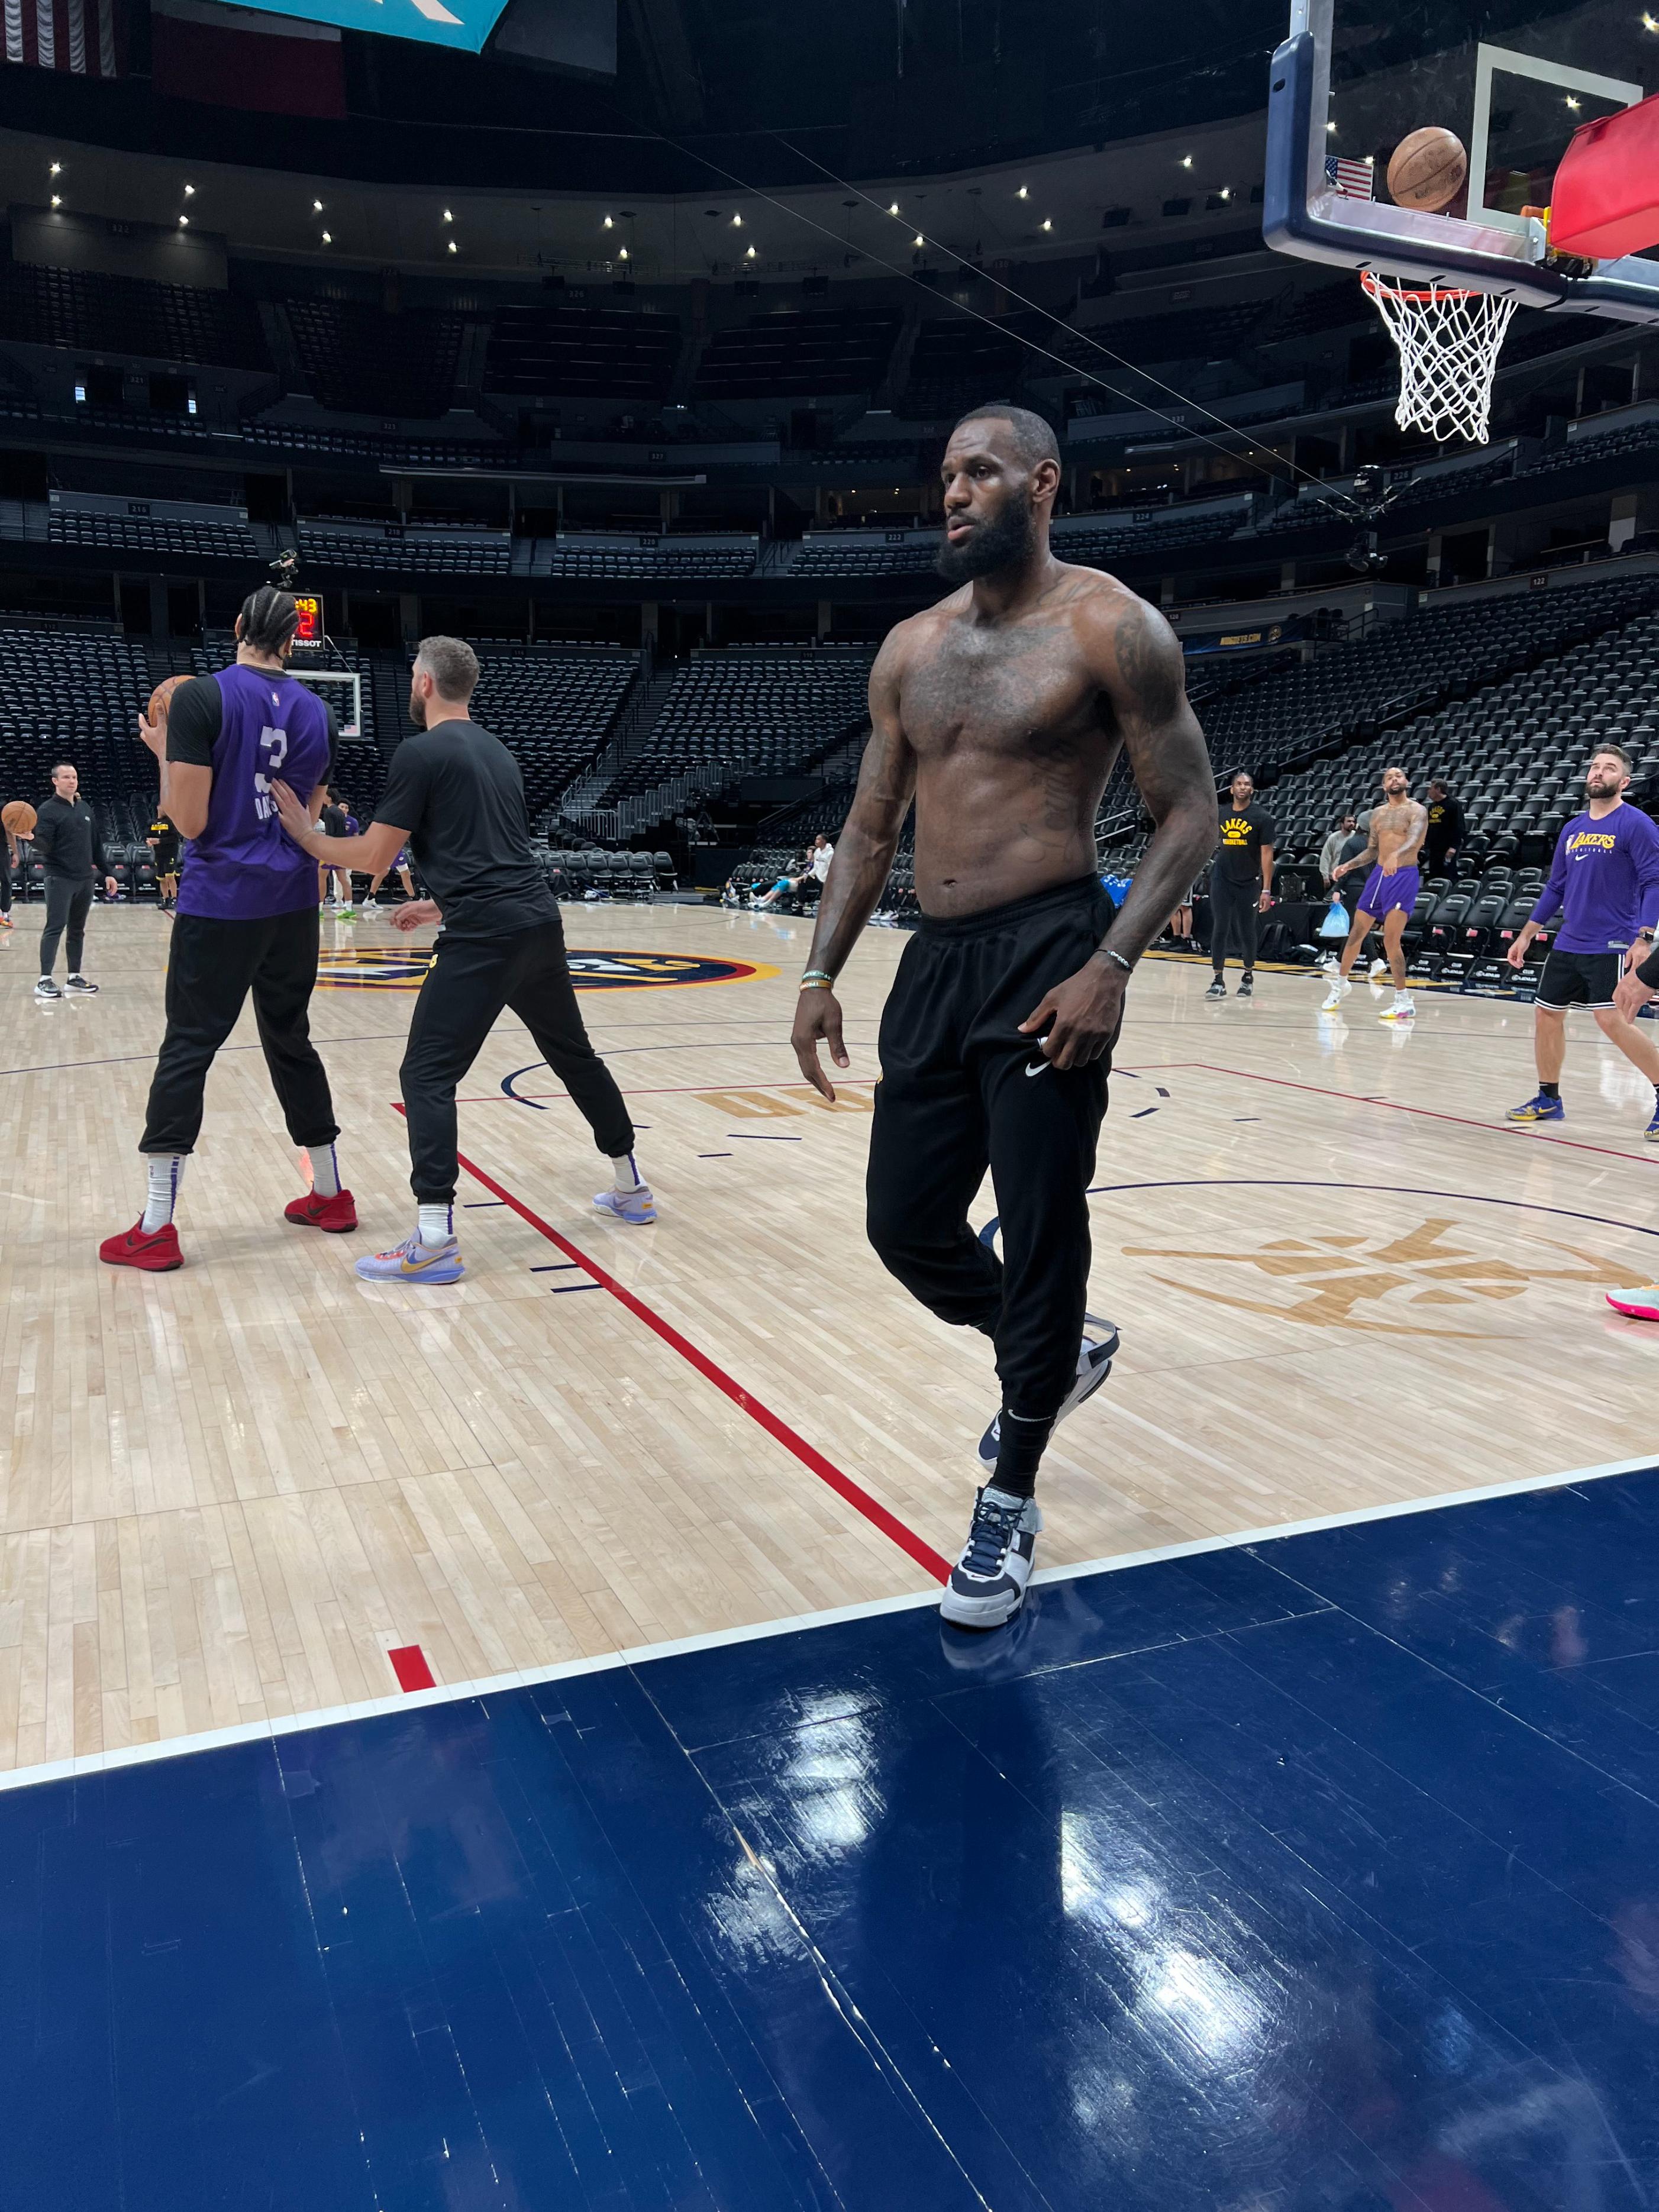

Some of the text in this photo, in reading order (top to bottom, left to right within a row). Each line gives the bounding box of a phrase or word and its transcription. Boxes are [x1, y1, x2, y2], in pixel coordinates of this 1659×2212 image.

[1393, 470, 1408, 480] 226
[1533, 577, 1545, 586] 122
[292, 639, 322, 647] TISSOT
[254, 725, 288, 793] 3
[1219, 818, 1253, 834] LAKERS
[1570, 831, 1616, 849] LAKERS
